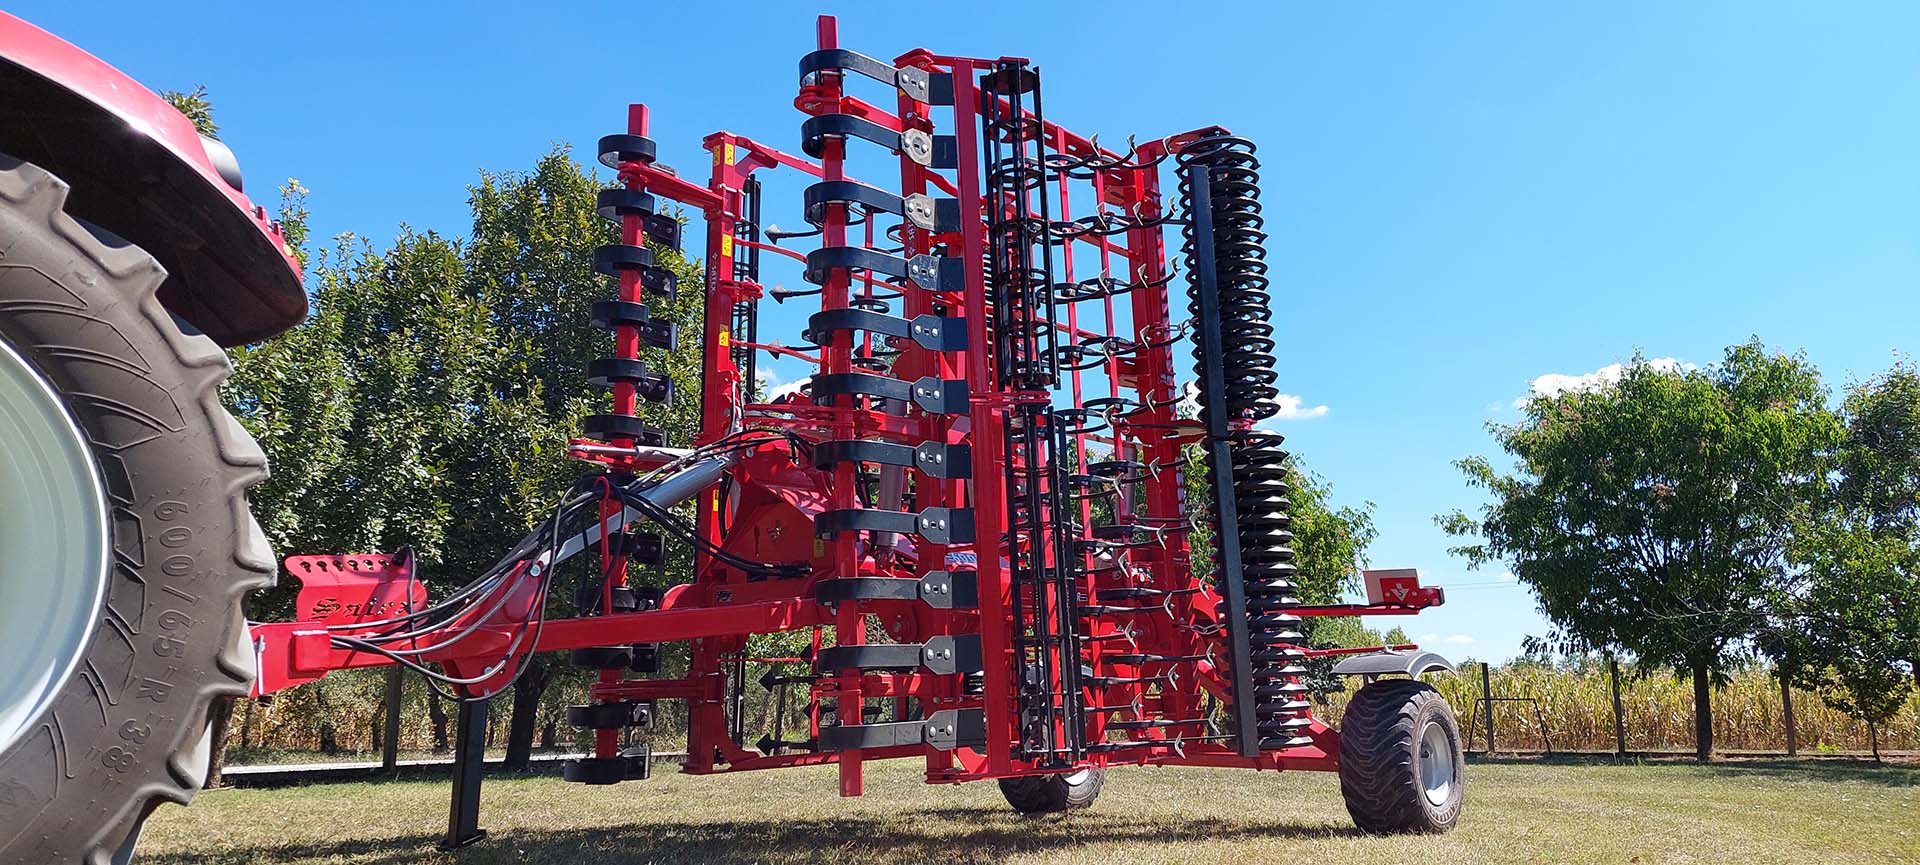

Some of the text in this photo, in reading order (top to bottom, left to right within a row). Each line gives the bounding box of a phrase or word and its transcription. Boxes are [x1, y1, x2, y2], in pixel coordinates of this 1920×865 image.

[101, 500, 196, 773] 600/65 R 38
